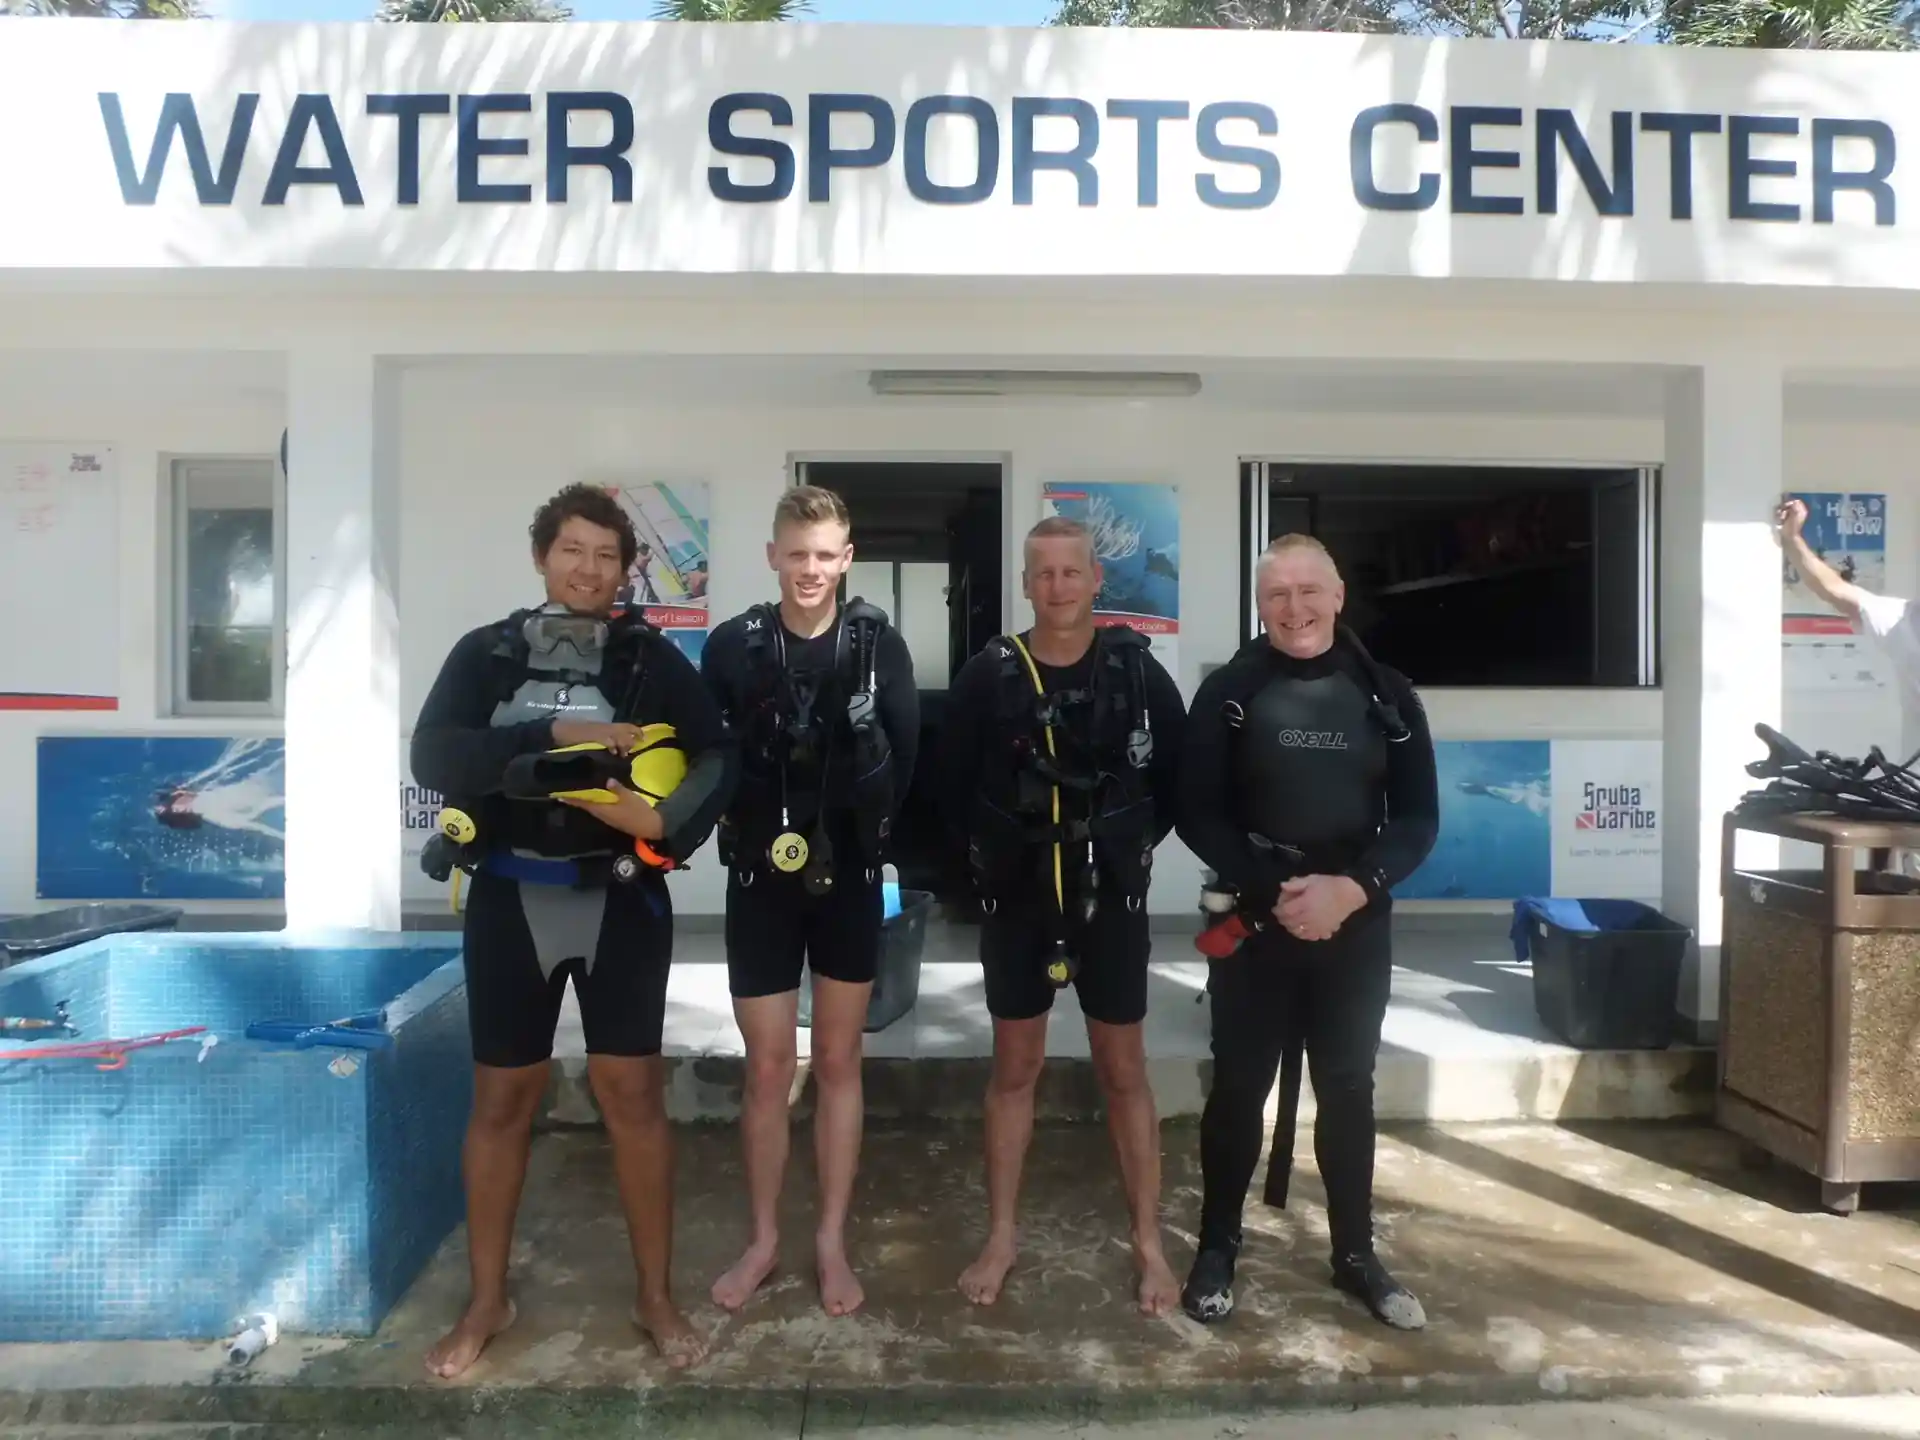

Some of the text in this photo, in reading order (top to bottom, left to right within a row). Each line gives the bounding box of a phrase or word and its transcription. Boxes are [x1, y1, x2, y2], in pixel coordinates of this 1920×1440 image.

[97, 92, 1896, 226] WATER SPORTS CENTER
